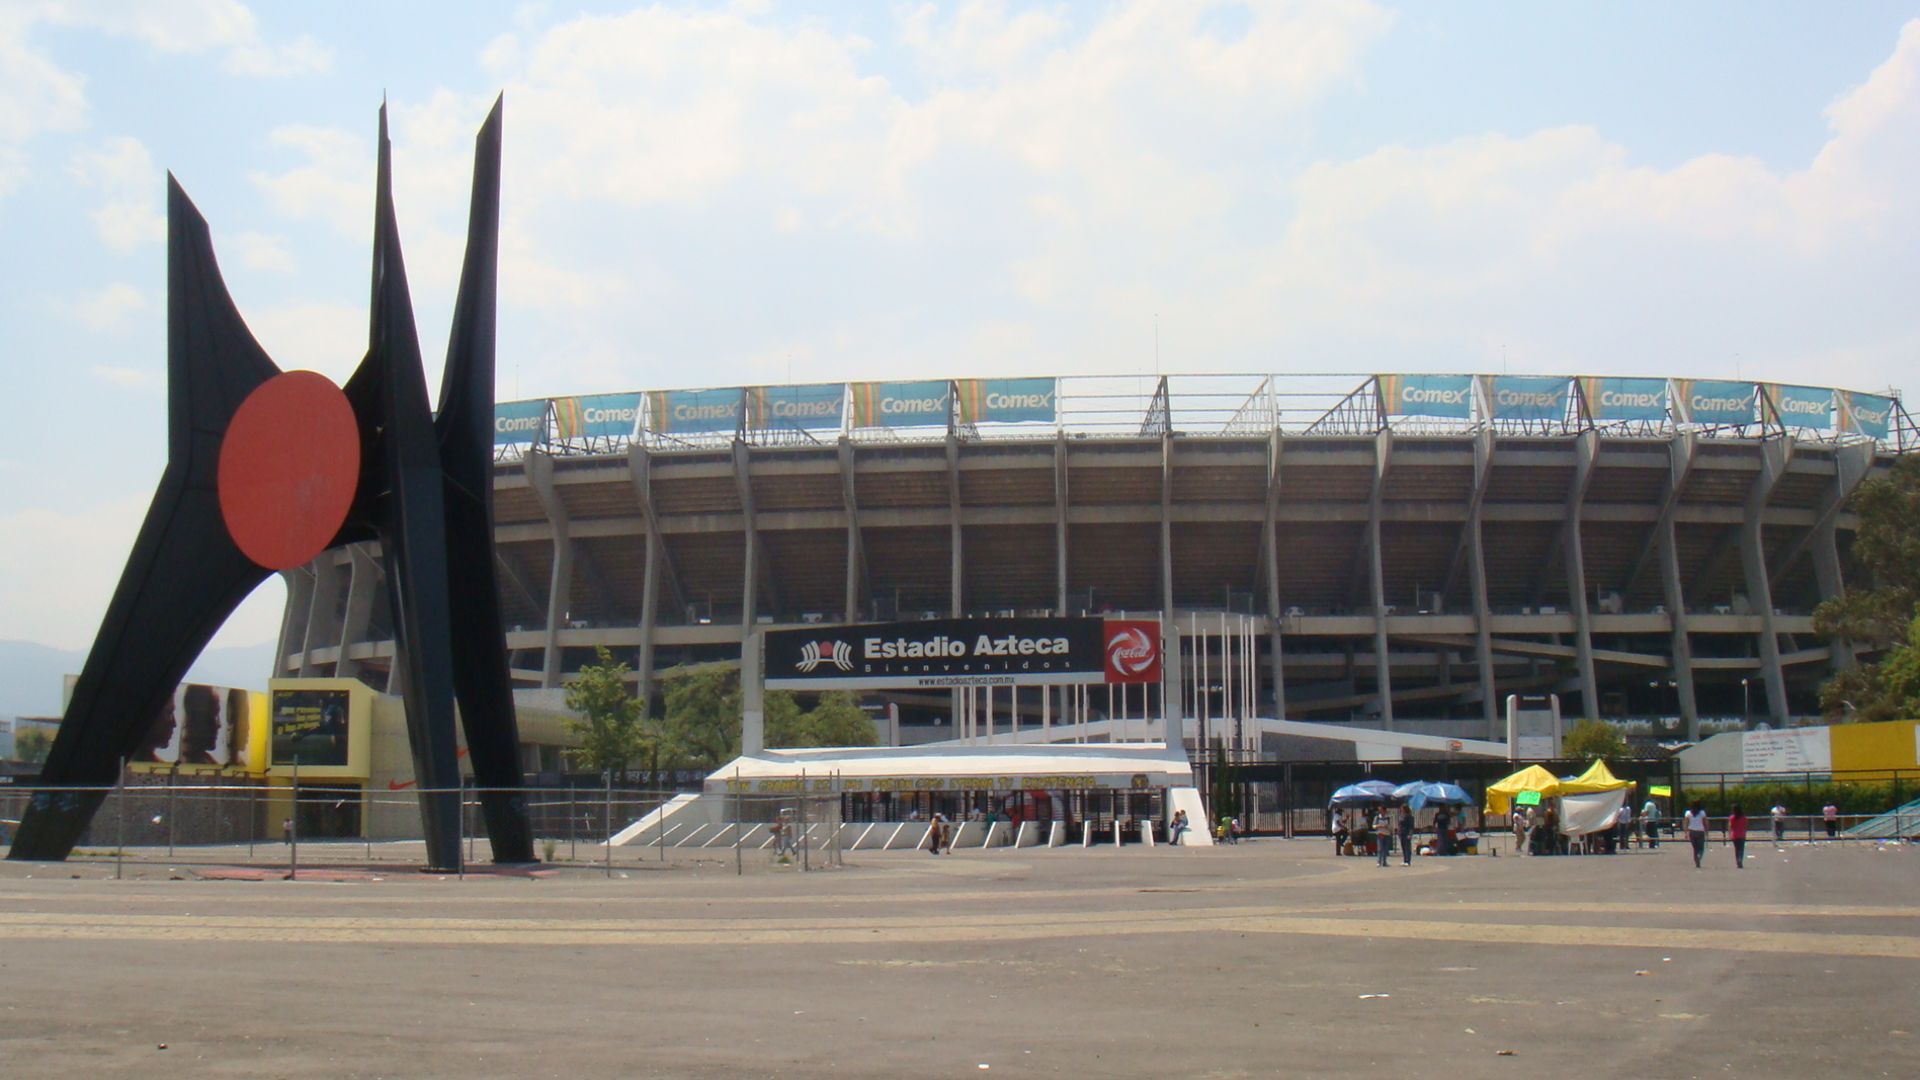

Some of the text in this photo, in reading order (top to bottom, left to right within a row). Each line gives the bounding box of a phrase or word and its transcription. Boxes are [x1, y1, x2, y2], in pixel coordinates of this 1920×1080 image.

[880, 394, 947, 413] Comex
[986, 391, 1053, 409] Comex
[1402, 387, 1469, 404] Comex
[1498, 389, 1564, 407] Comex
[1601, 391, 1664, 407] Comex
[1692, 395, 1751, 411] Comex
[673, 401, 739, 420] Comex
[773, 398, 839, 417] Comex
[1781, 397, 1830, 415] Comex
[495, 415, 541, 432] Come
[864, 634, 1069, 659] Estadio Azteca
